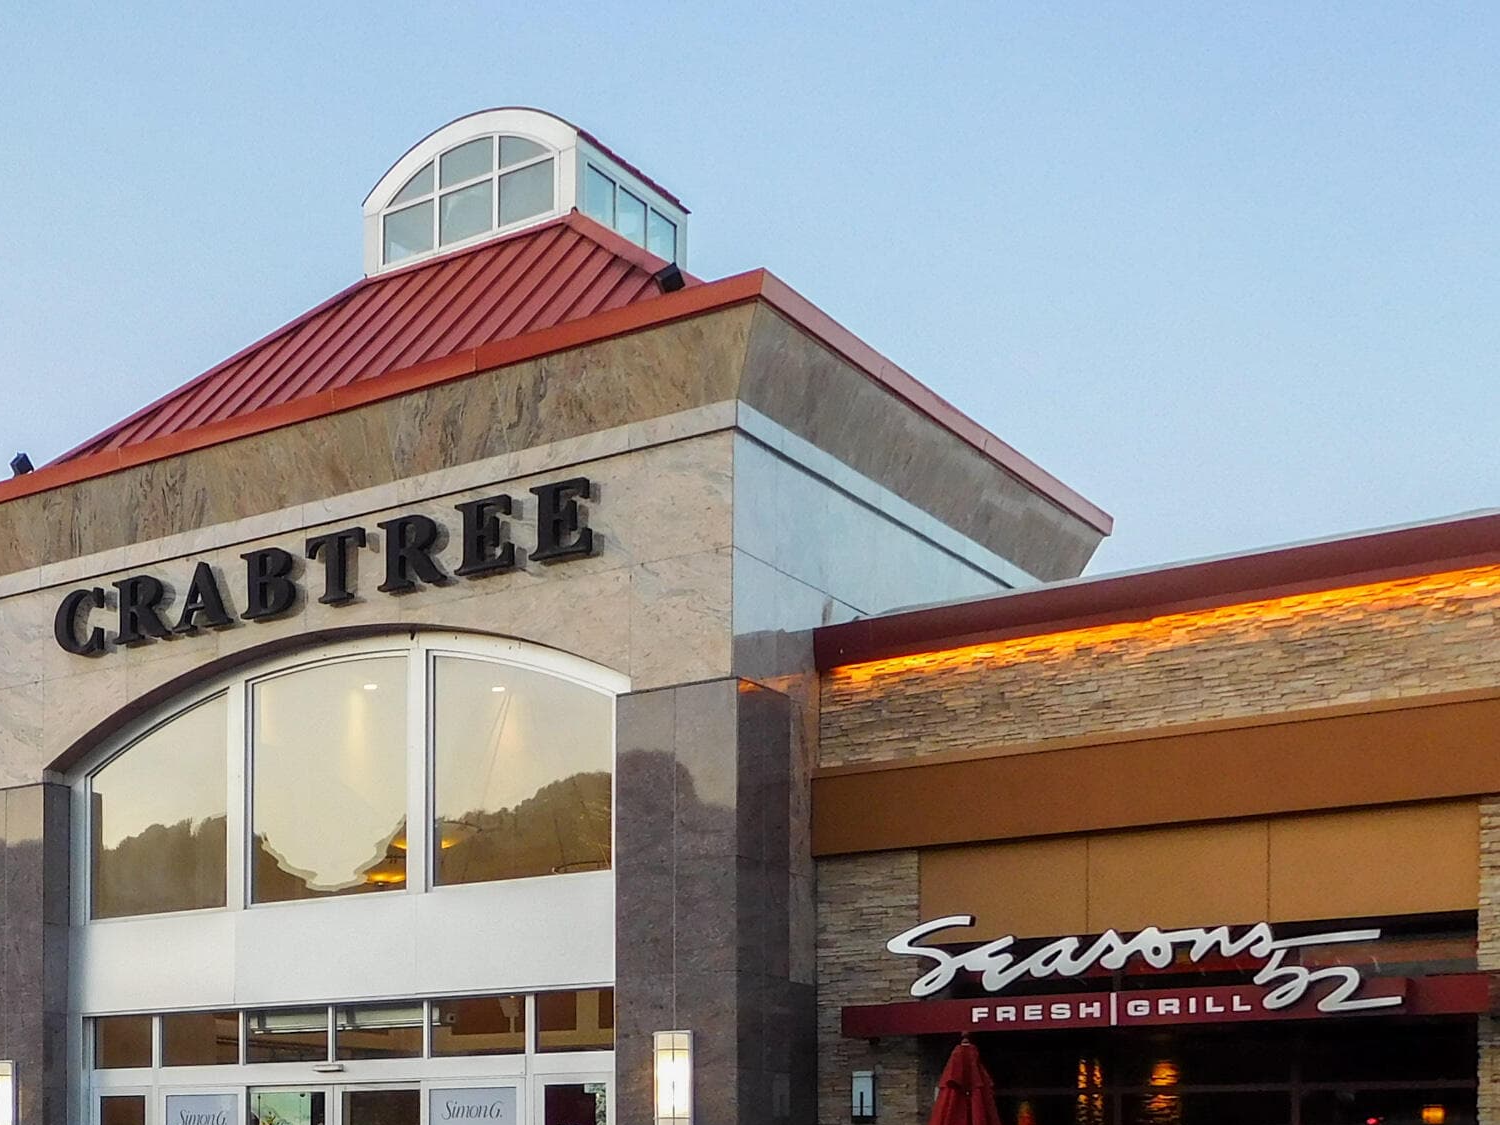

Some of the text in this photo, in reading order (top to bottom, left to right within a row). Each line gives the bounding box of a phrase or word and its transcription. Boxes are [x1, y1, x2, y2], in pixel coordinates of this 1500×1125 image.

[53, 477, 596, 655] CRABTREE
[886, 915, 1380, 997] Seasons
[971, 995, 1251, 1023] FRESH GRILL
[441, 1100, 488, 1120] Simon
